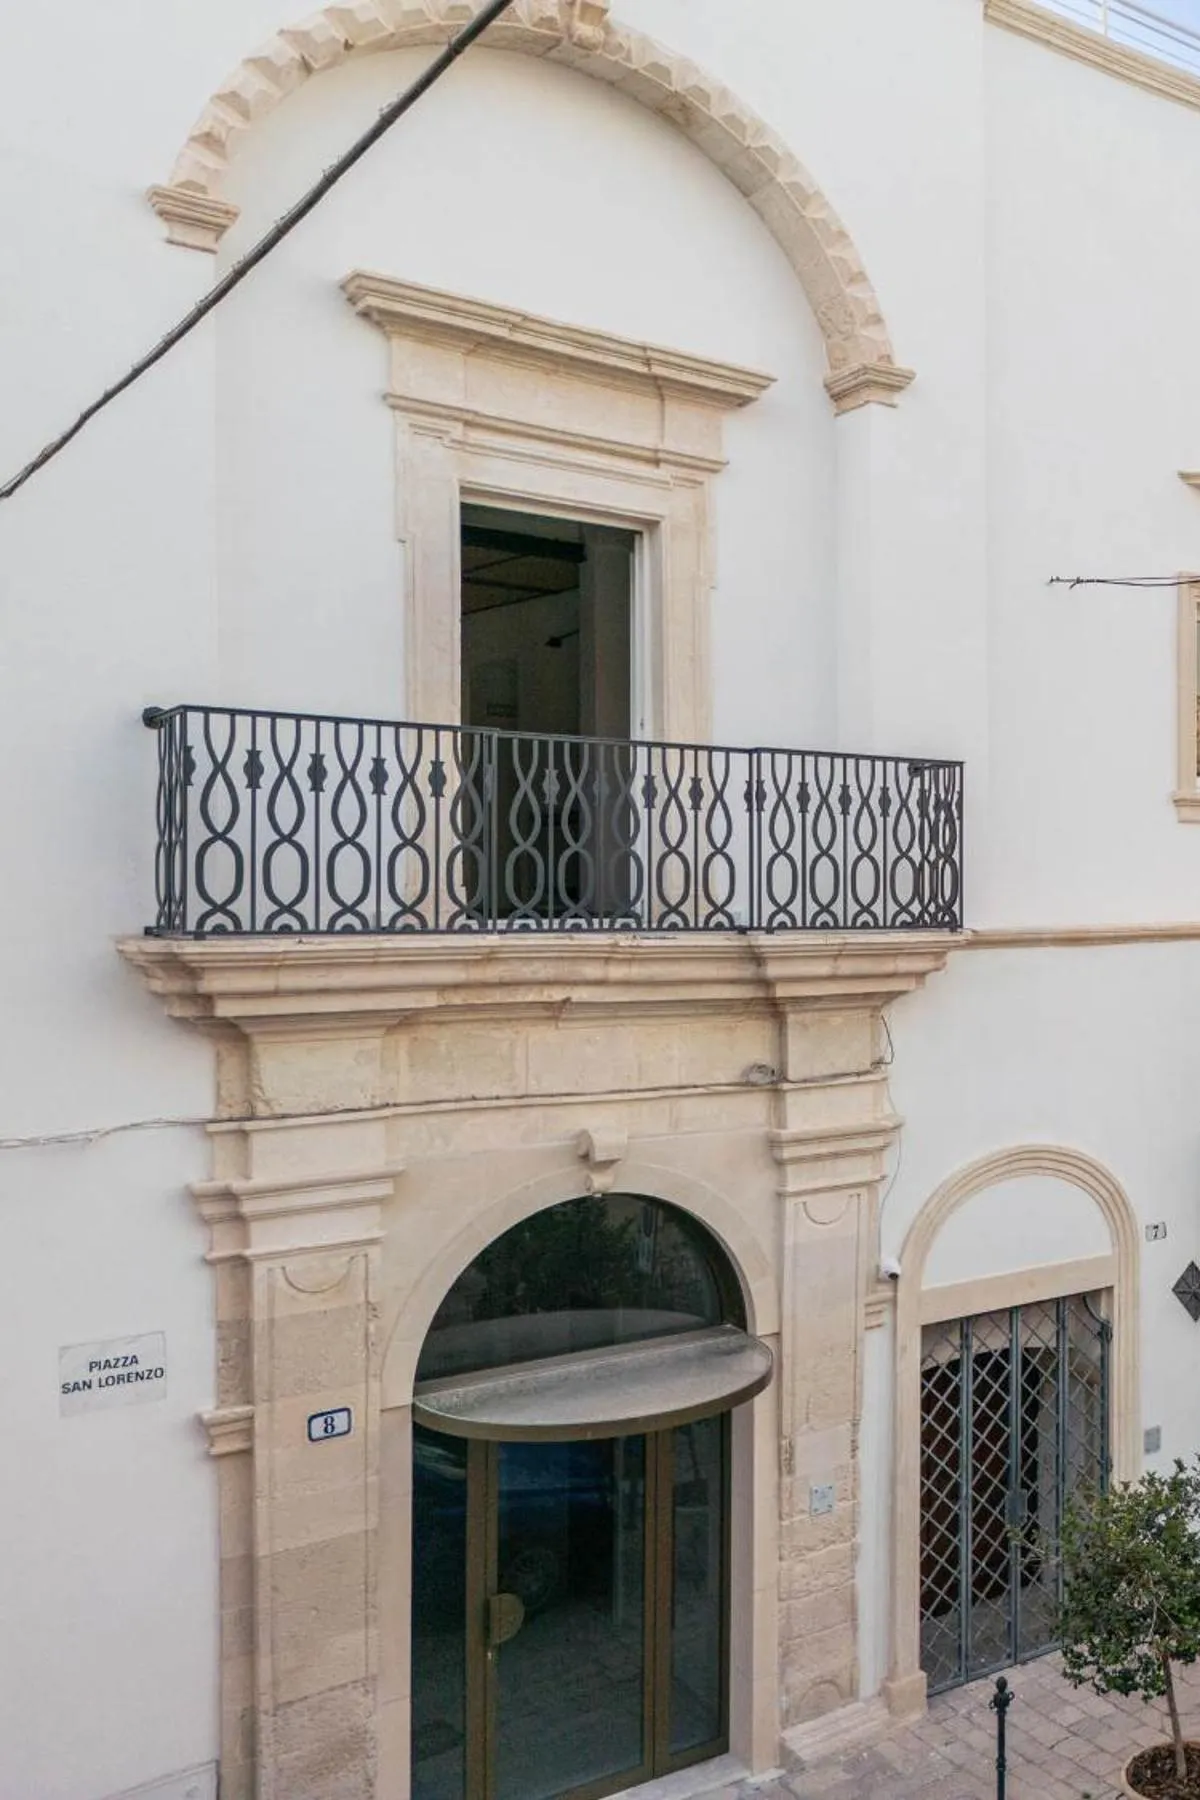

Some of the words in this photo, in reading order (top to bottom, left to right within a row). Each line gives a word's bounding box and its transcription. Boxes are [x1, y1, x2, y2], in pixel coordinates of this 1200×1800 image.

[88, 1355, 139, 1373] PIAZZA
[61, 1379, 92, 1395] SAN
[98, 1367, 164, 1388] LORENZO
[323, 1415, 335, 1434] 8
